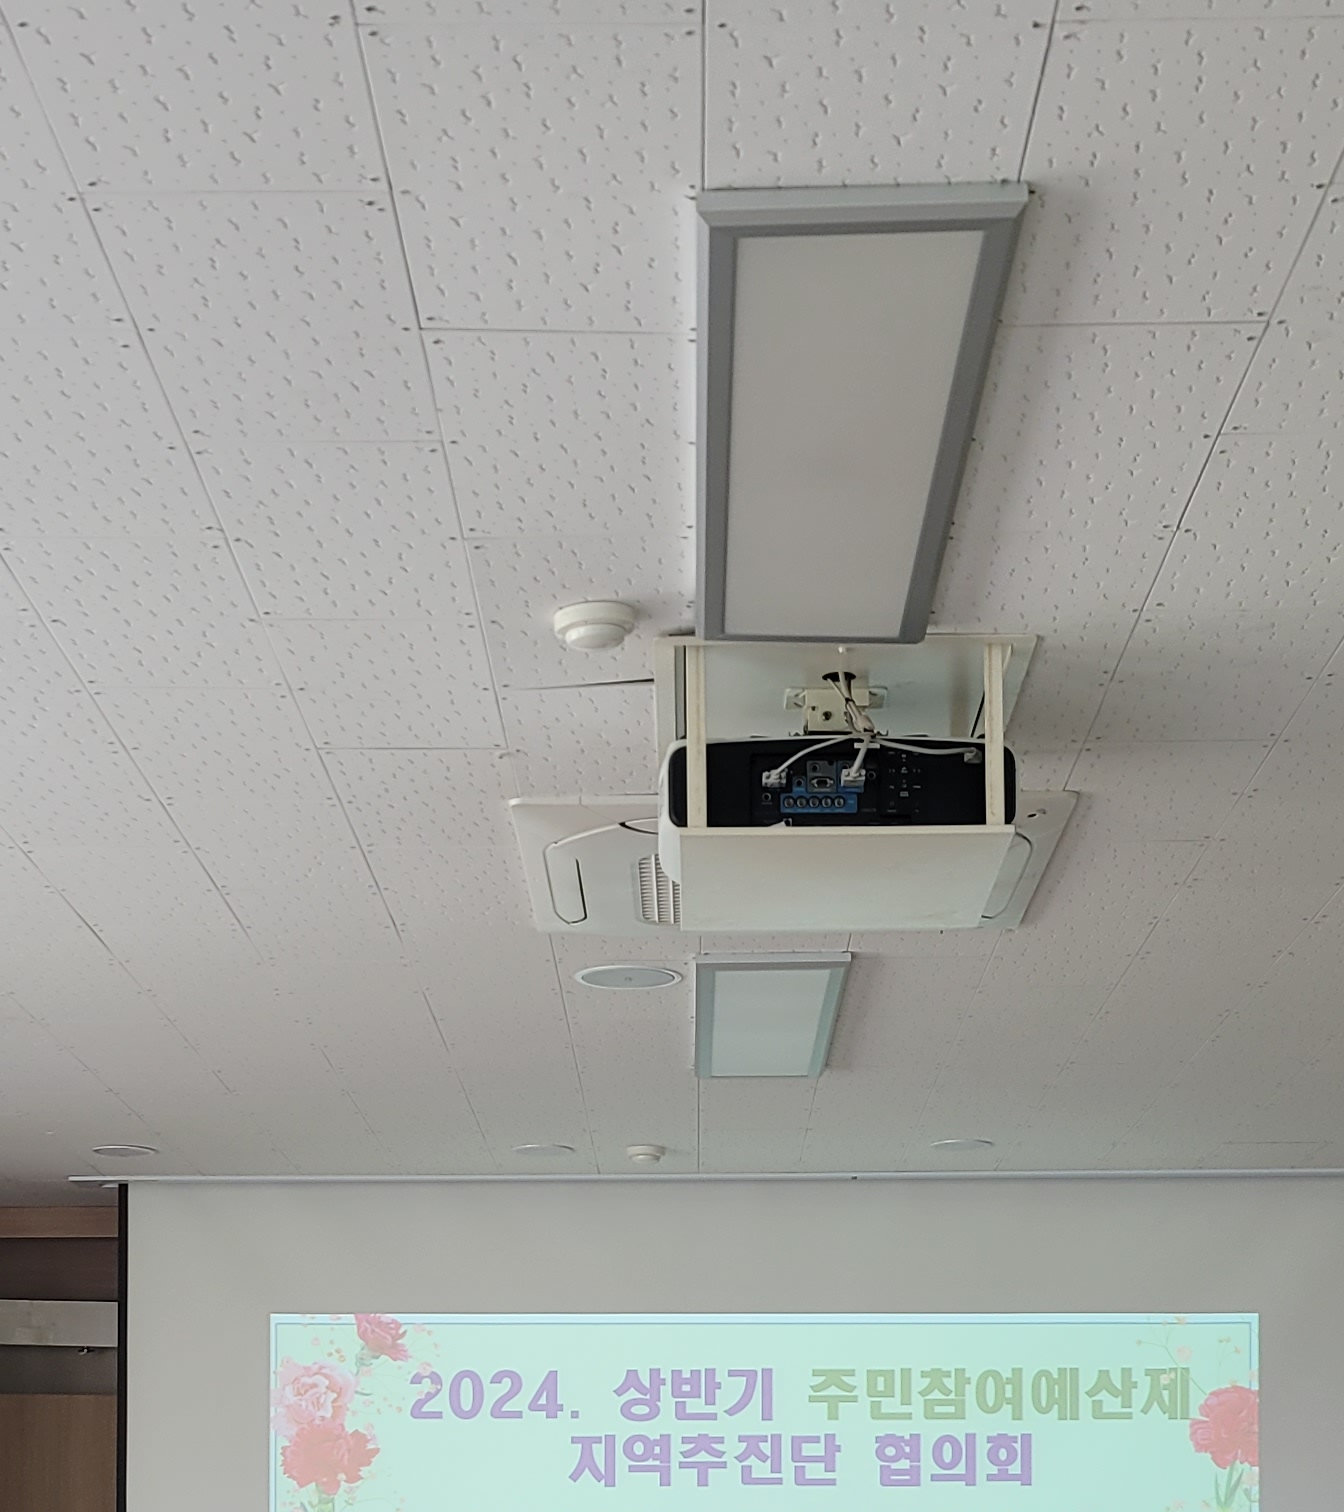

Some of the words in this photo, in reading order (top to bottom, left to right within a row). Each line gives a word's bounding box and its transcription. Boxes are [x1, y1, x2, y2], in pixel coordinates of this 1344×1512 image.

[409, 1369, 580, 1420] 2024.
[613, 1367, 774, 1422] 상반기
[808, 1367, 1191, 1421] 주민참여예산제
[568, 1432, 842, 1488] 지역추진단
[874, 1432, 1033, 1487] 협의회
